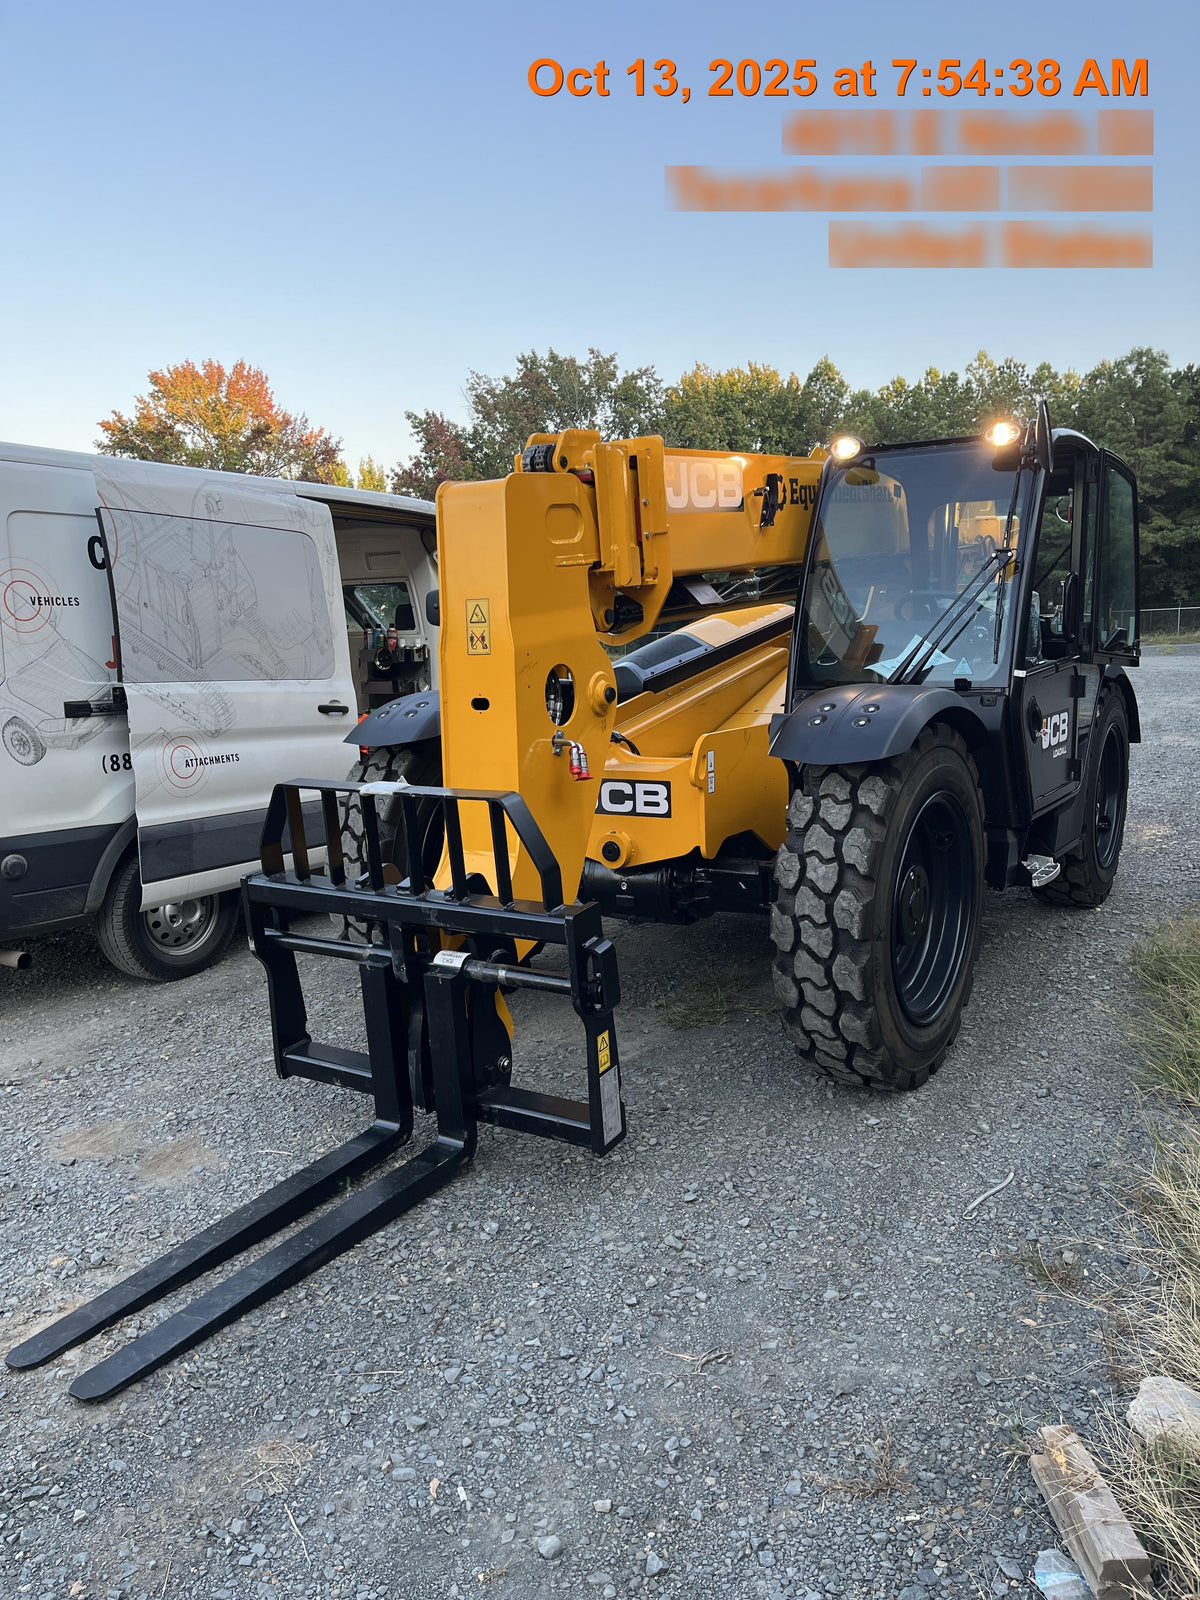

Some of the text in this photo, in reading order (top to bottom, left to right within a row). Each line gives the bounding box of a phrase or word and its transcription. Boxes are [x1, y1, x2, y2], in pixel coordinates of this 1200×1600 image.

[665, 461, 743, 509] JCB
[29, 596, 80, 607] VEHICLES
[1041, 711, 1069, 750] JCB
[185, 753, 240, 768] ATTACHMENTS
[595, 781, 669, 815] CB
